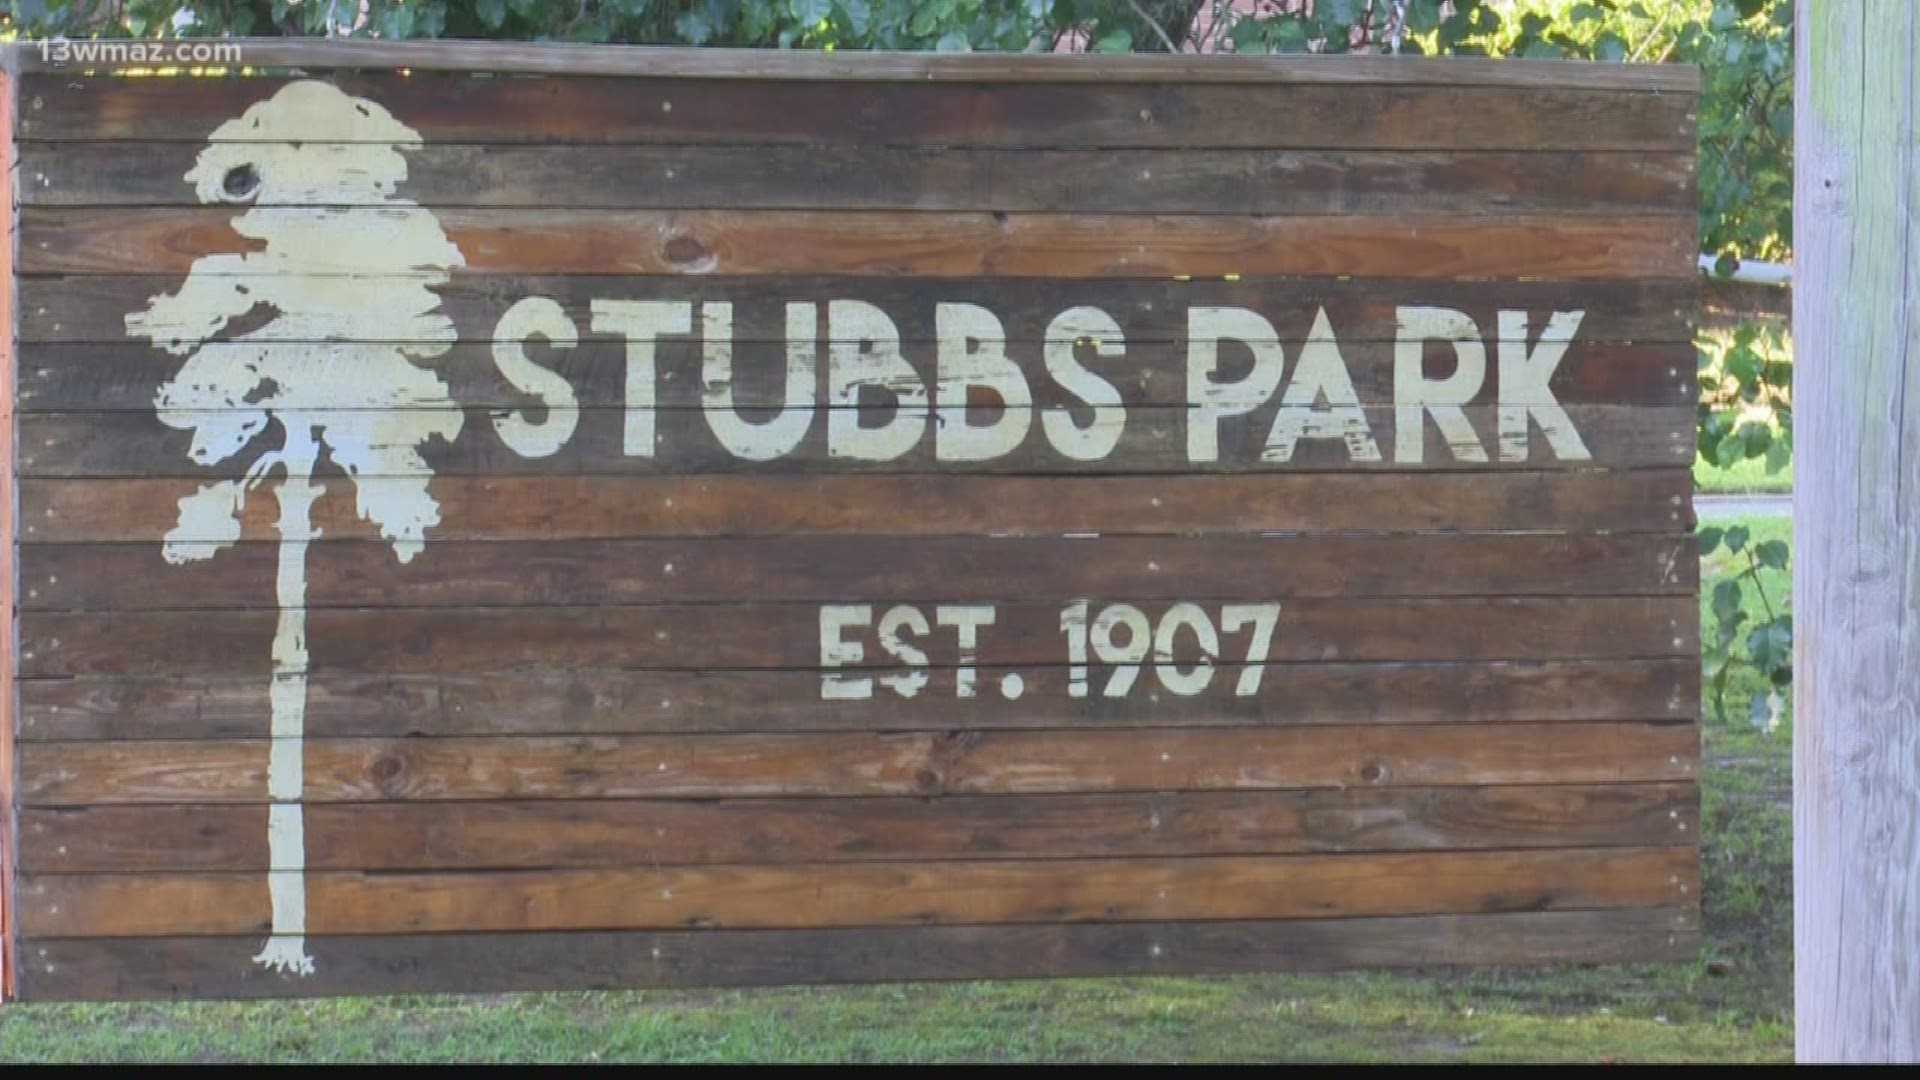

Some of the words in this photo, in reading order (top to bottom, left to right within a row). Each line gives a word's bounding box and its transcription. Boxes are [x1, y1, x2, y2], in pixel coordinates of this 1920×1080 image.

[490, 296, 1127, 463] STUBBS
[1185, 305, 1593, 465] PARK
[818, 604, 1025, 701] EST.
[1061, 600, 1282, 699] 1907
